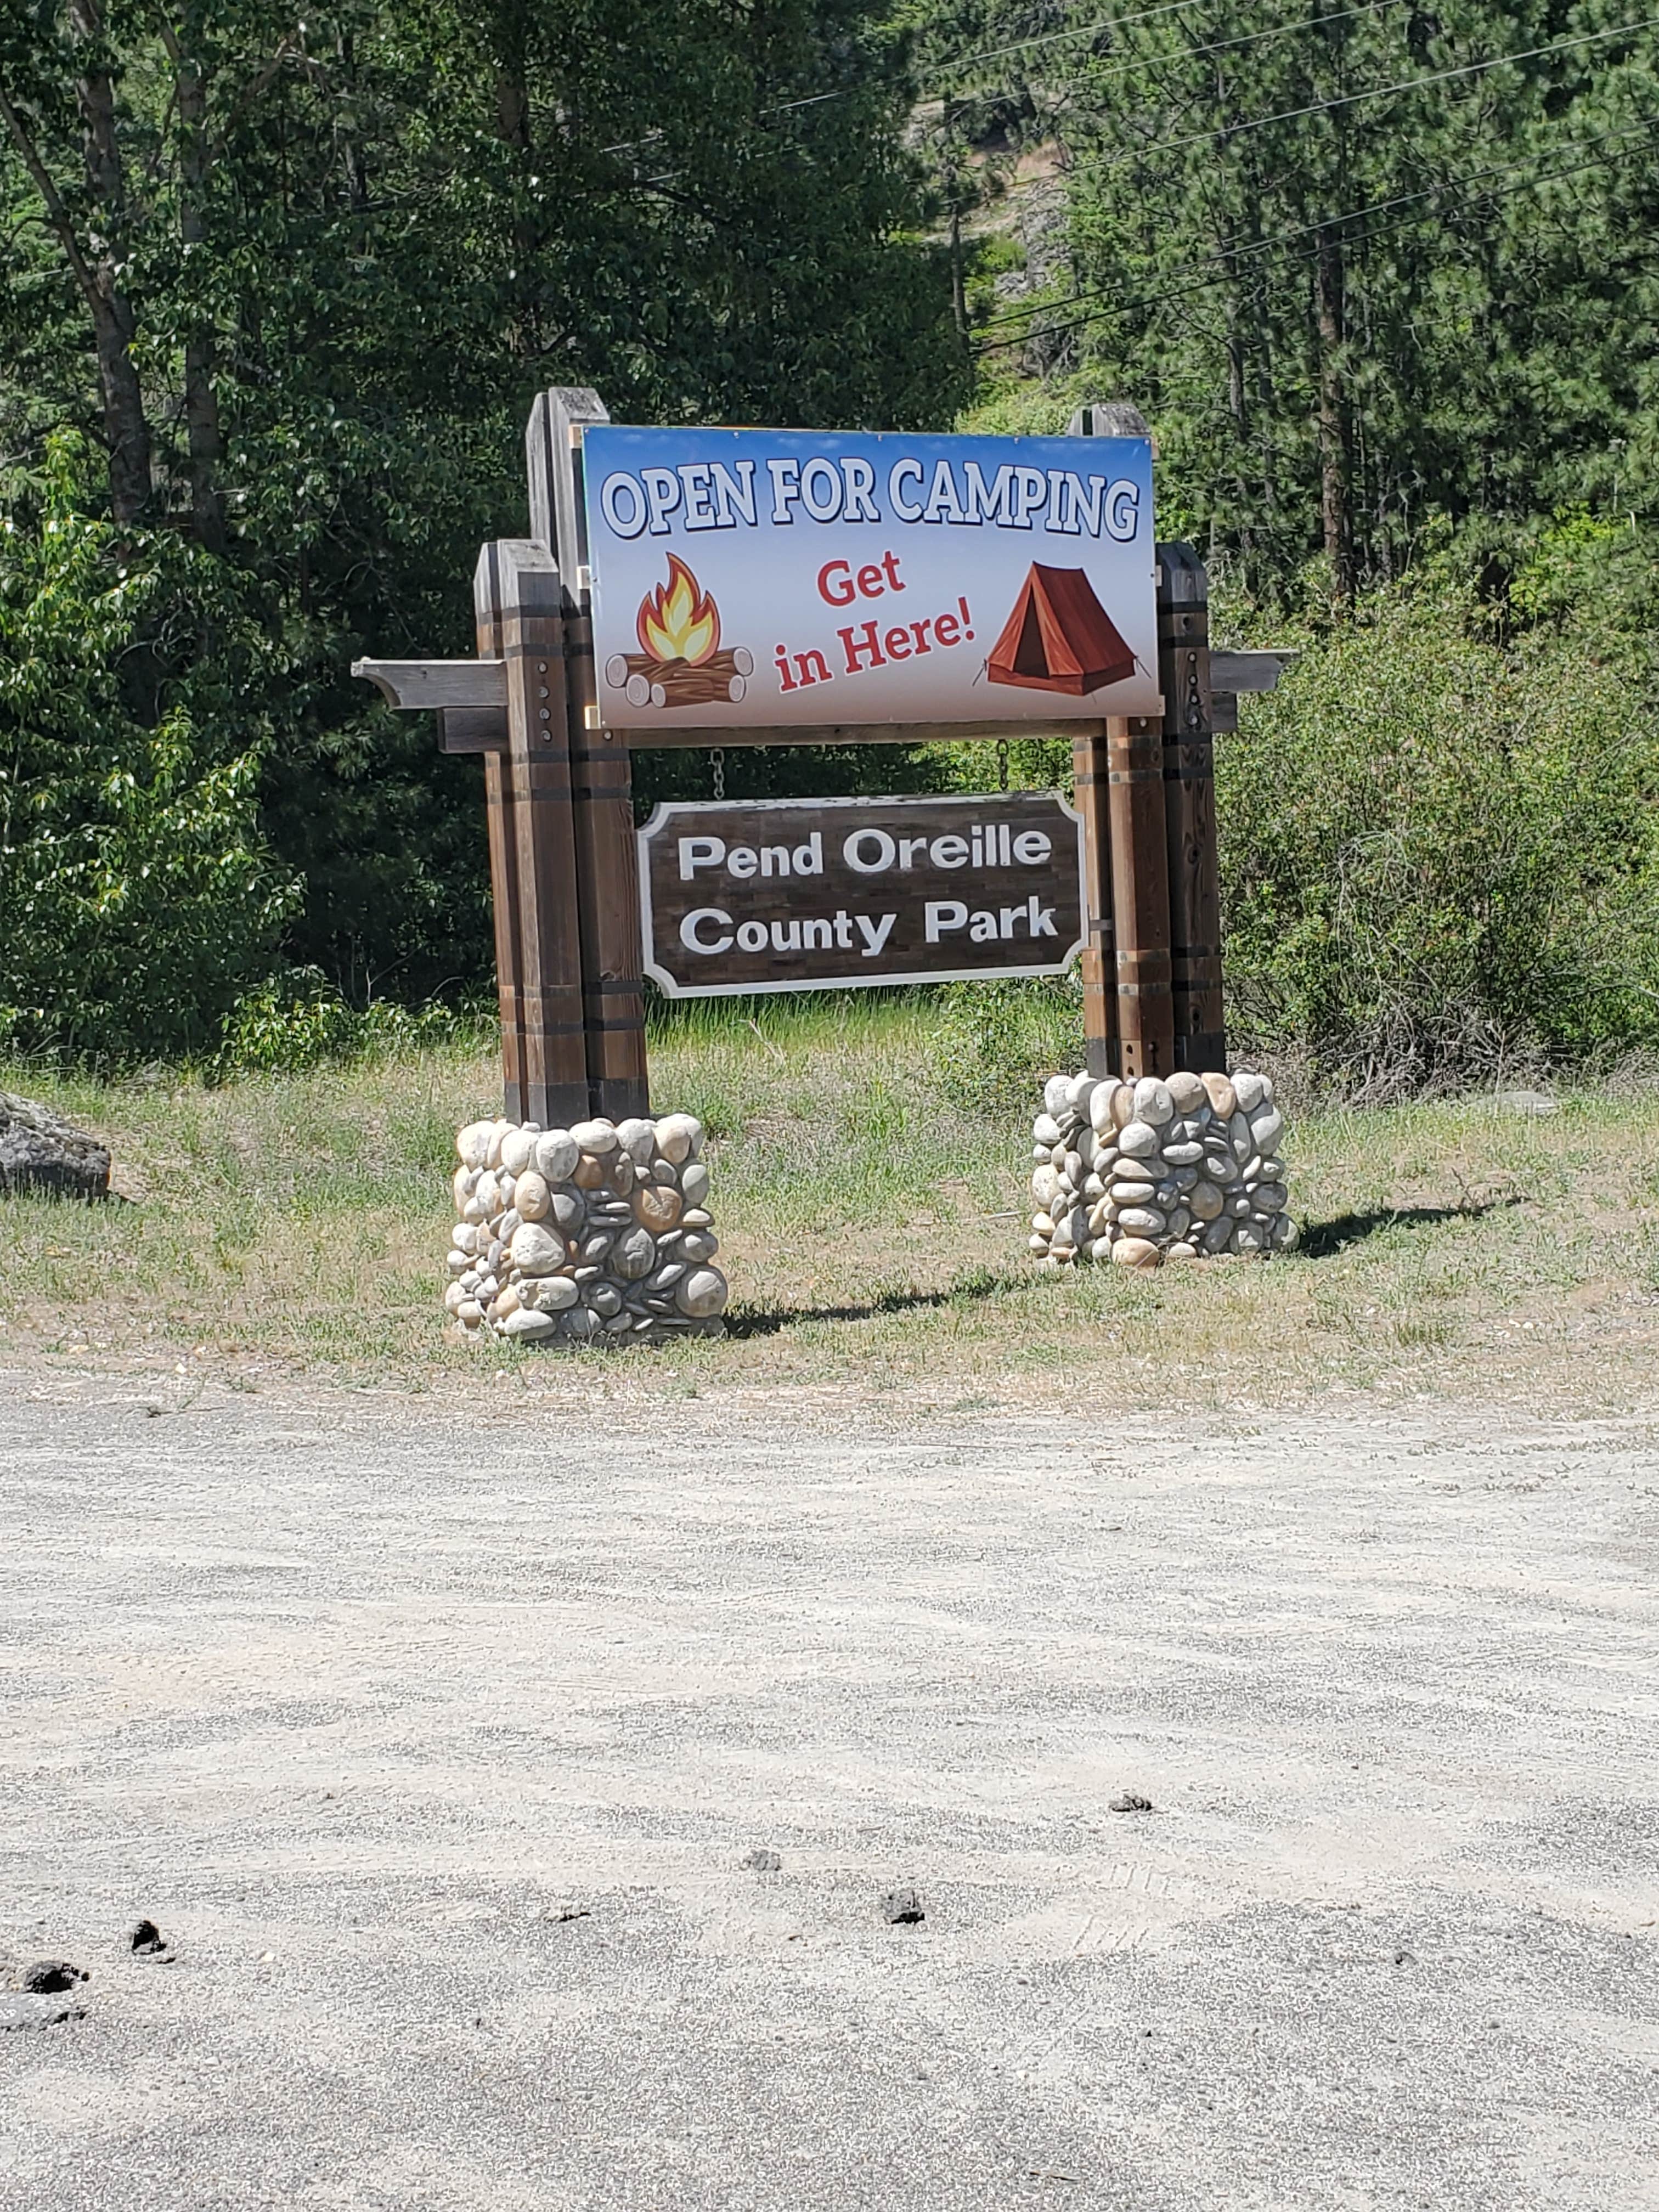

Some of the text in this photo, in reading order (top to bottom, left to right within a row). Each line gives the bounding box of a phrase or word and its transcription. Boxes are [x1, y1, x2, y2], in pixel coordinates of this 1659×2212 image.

[601, 456, 1140, 542] OPEN FOR CAMPING
[817, 550, 906, 607] Get
[774, 596, 975, 694] in Here!
[678, 824, 1052, 881] Pend Oreille
[680, 895, 1058, 957] County Park
